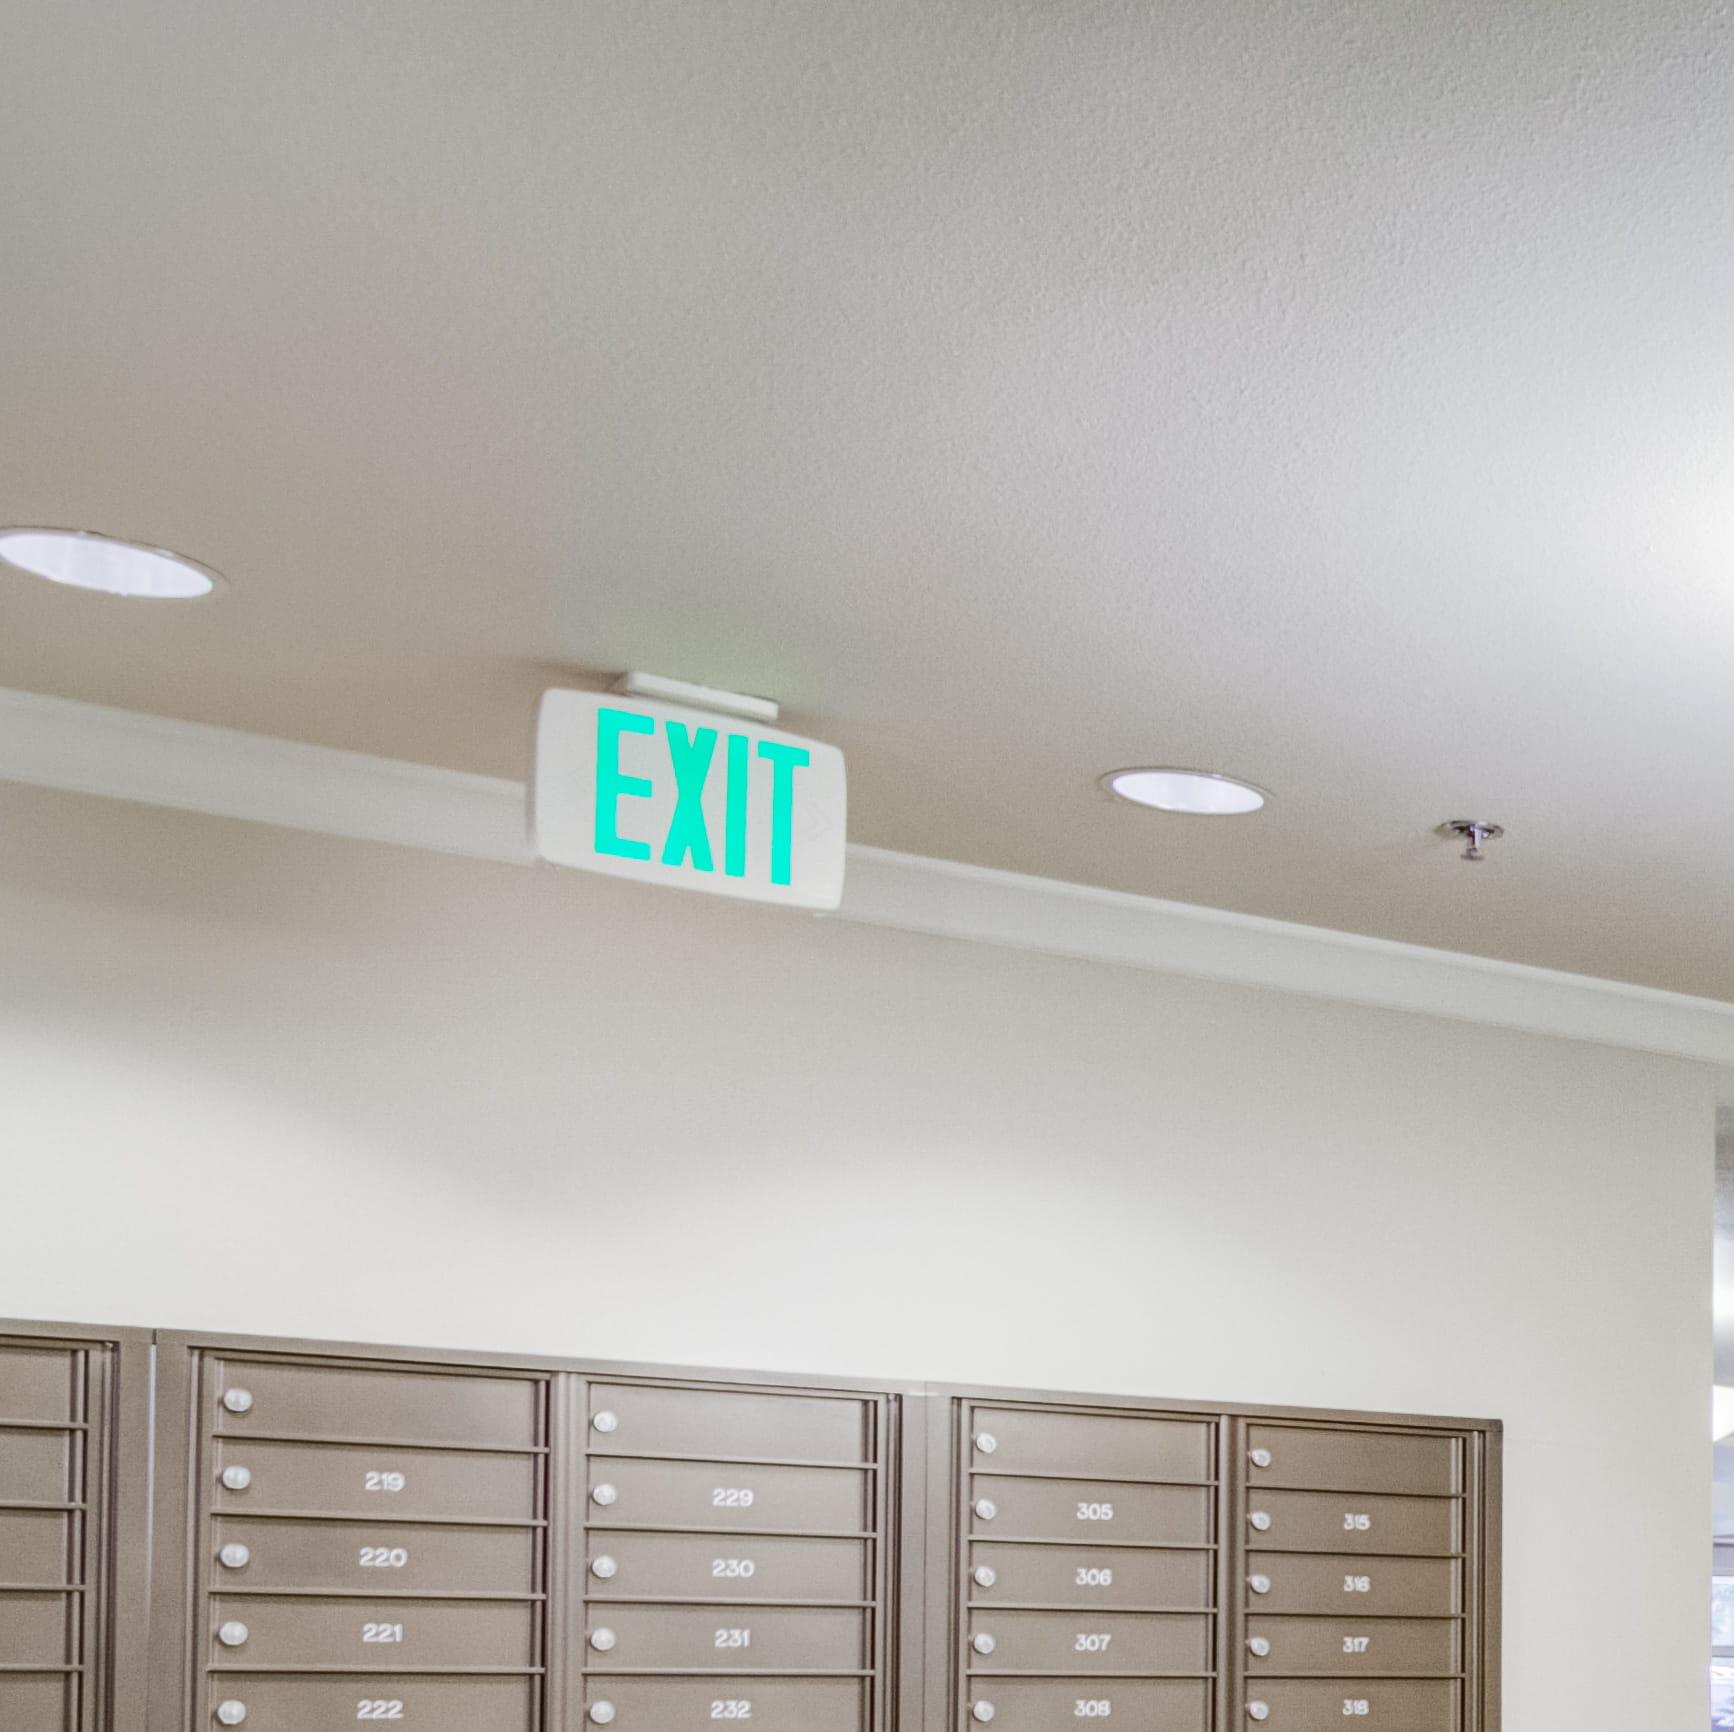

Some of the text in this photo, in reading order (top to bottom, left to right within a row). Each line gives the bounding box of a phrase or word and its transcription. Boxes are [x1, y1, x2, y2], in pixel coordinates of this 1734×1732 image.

[594, 707, 810, 887] EXIT
[365, 1471, 405, 1492] 219
[712, 1487, 754, 1507] 229
[1076, 1502, 1114, 1521] 305
[1343, 1513, 1371, 1531] 315
[359, 1546, 408, 1568] 220
[712, 1558, 755, 1578] 230
[1075, 1567, 1112, 1586] 306
[362, 1622, 403, 1643] 221
[714, 1628, 751, 1648] 231
[1074, 1633, 1112, 1652] 307
[1342, 1636, 1370, 1653] 317
[356, 1699, 404, 1720] 222
[710, 1700, 752, 1719] 232
[1073, 1699, 1111, 1717] 308
